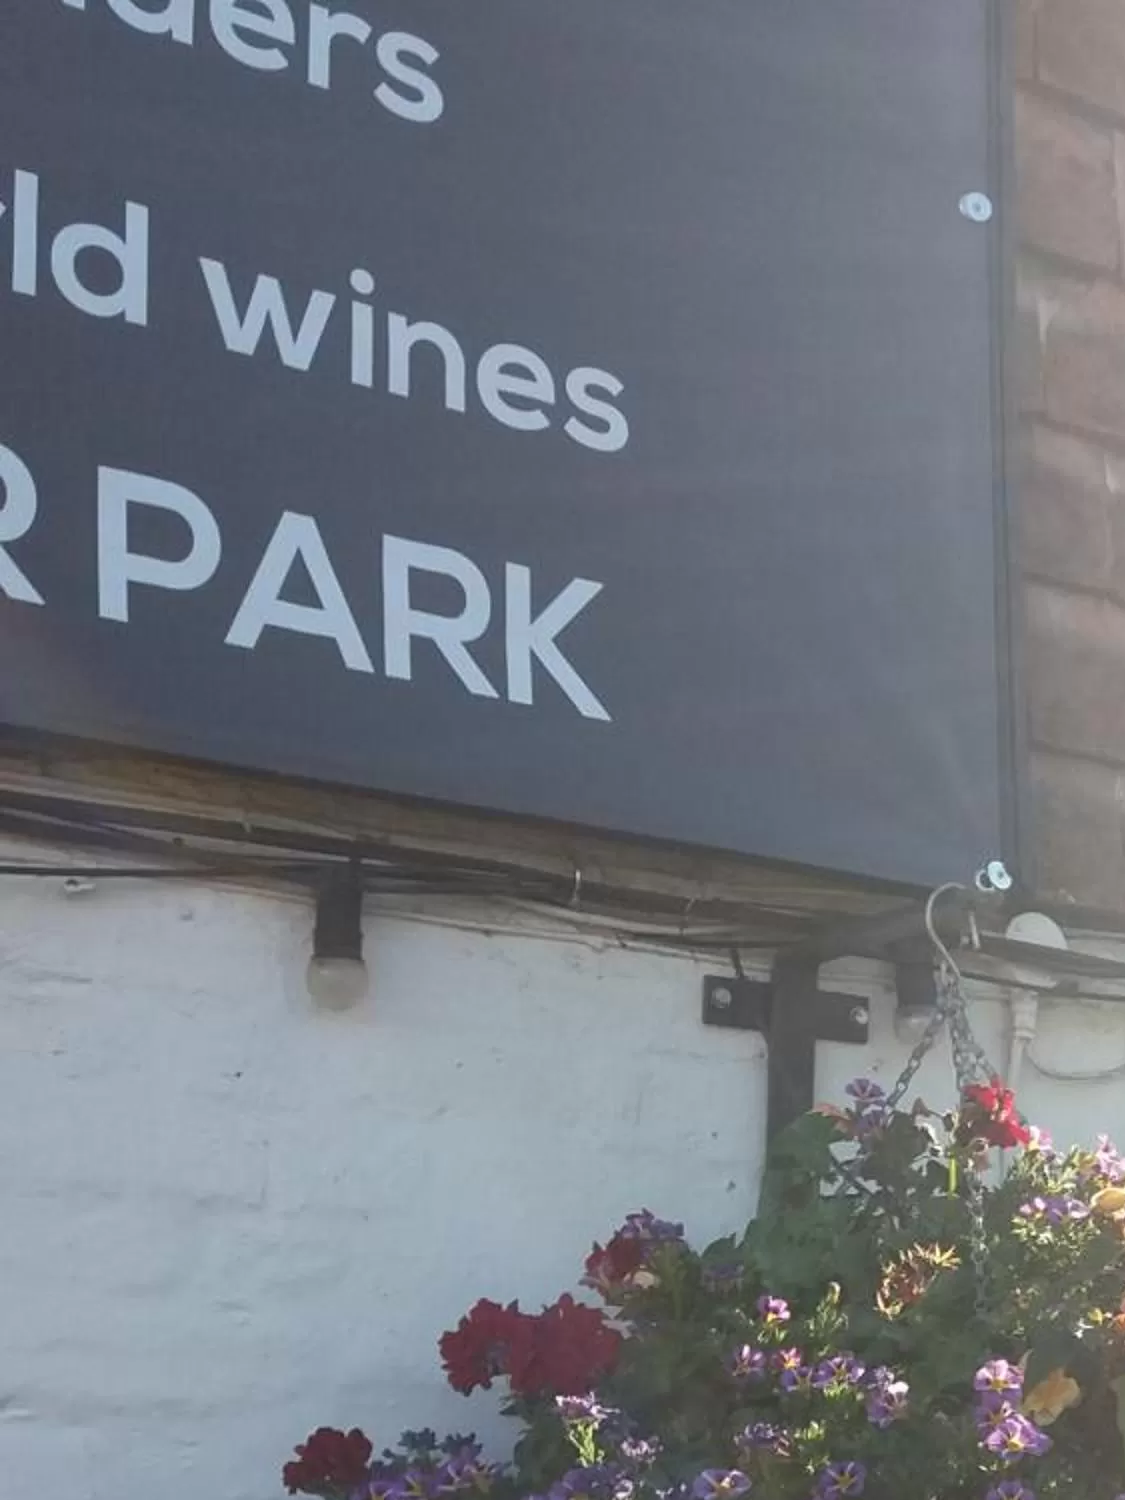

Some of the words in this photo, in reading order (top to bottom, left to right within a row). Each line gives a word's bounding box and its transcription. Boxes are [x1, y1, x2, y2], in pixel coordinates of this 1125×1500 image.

[62, 0, 445, 123] ers
[0, 168, 149, 327] ld
[199, 256, 630, 452] wines
[97, 465, 612, 722] PARK
